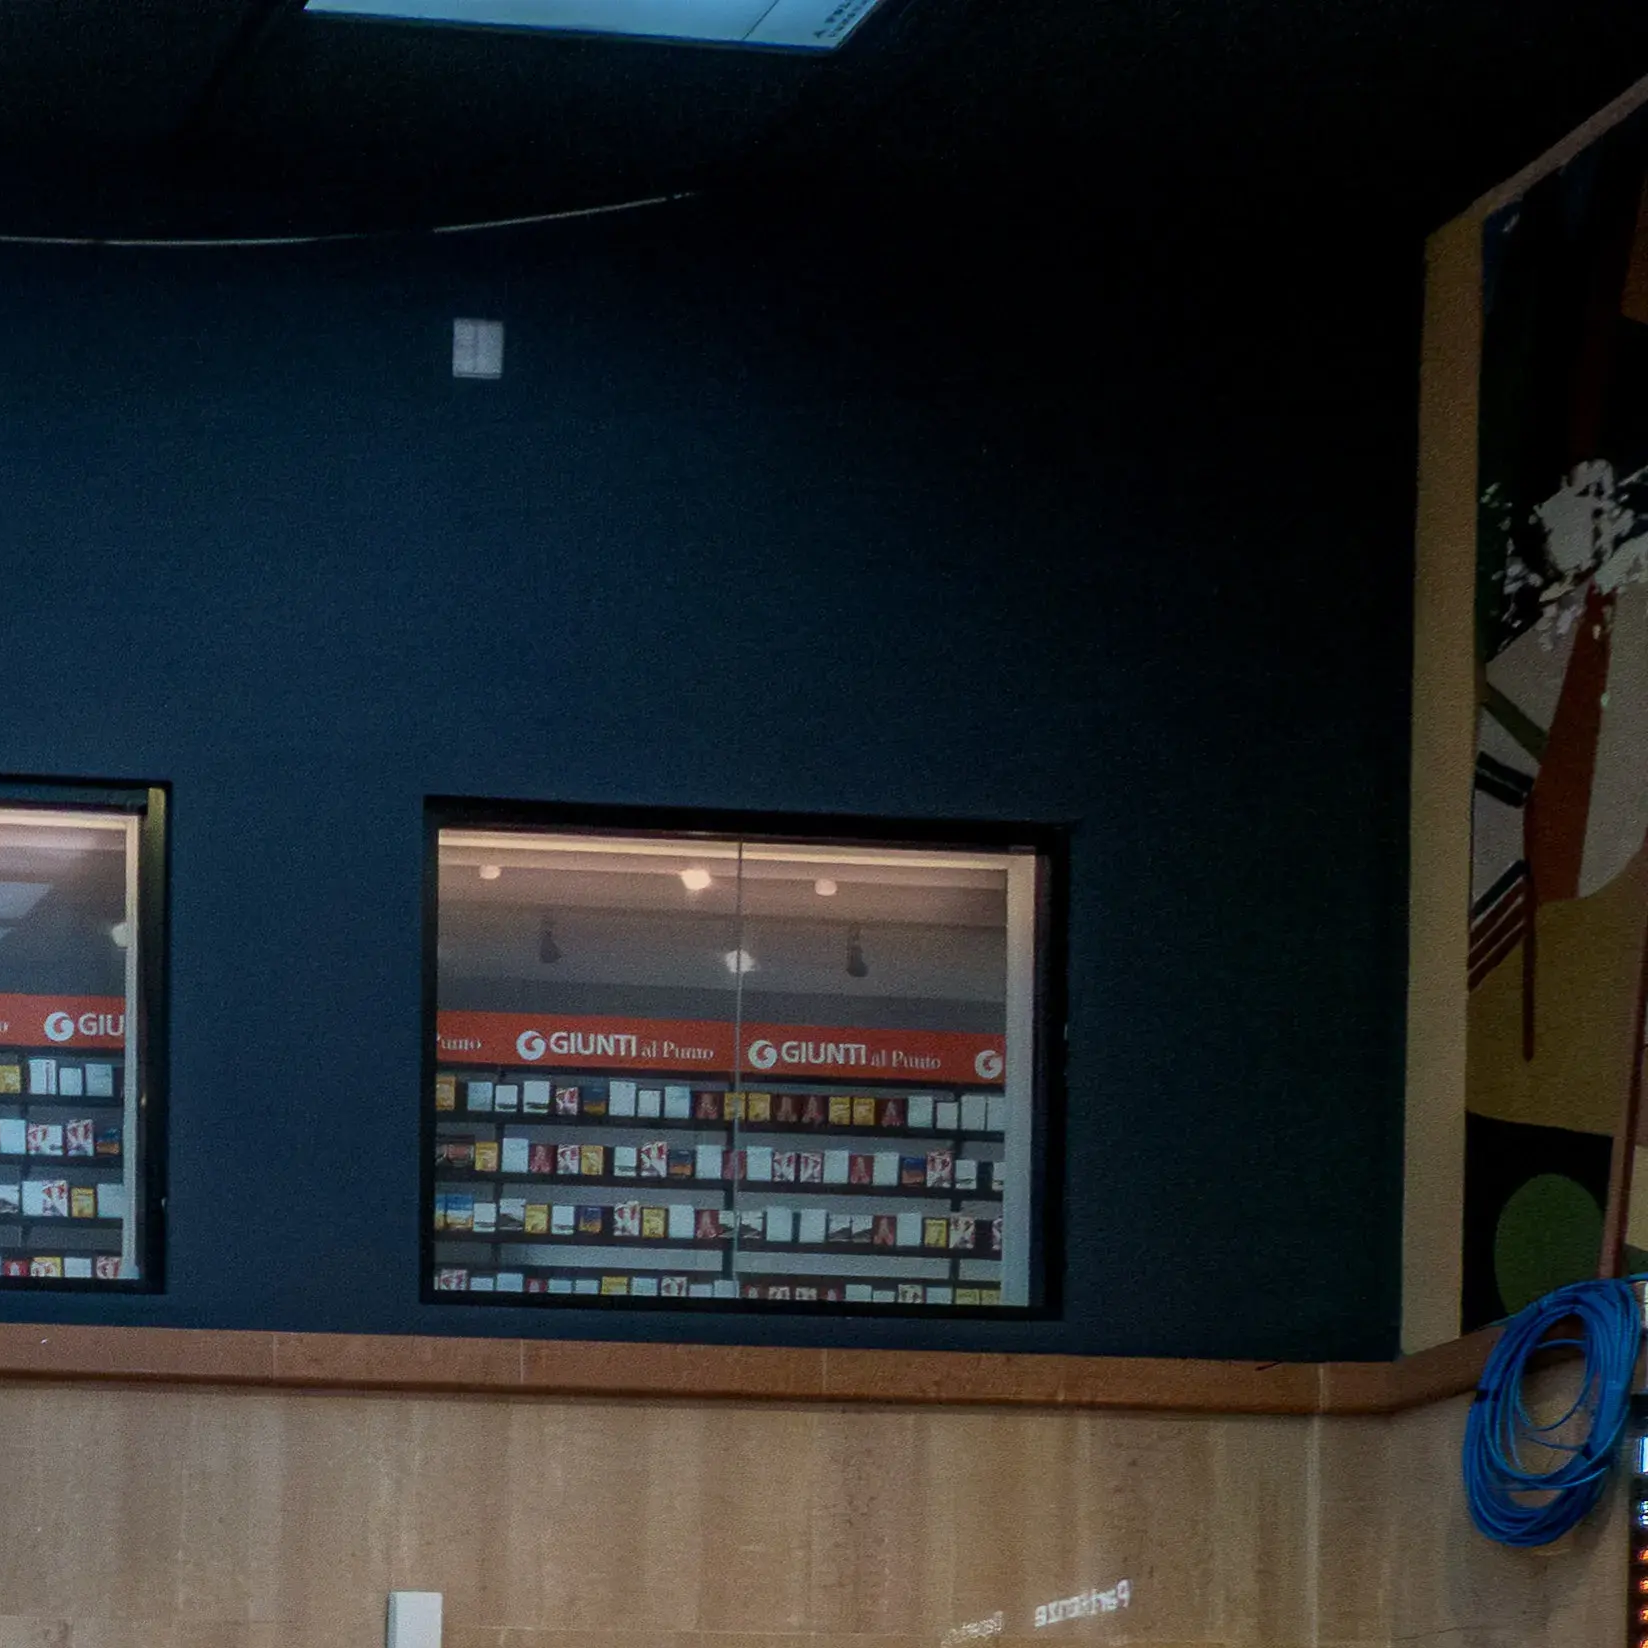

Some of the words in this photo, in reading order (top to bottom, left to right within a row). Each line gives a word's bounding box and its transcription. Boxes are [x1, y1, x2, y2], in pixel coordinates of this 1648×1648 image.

[76, 1013, 124, 1036] GIU
[549, 1031, 638, 1058] GIUNTI
[662, 1042, 715, 1061] Punto
[780, 1040, 867, 1066] GIUNTI
[891, 1050, 942, 1070] Punto
